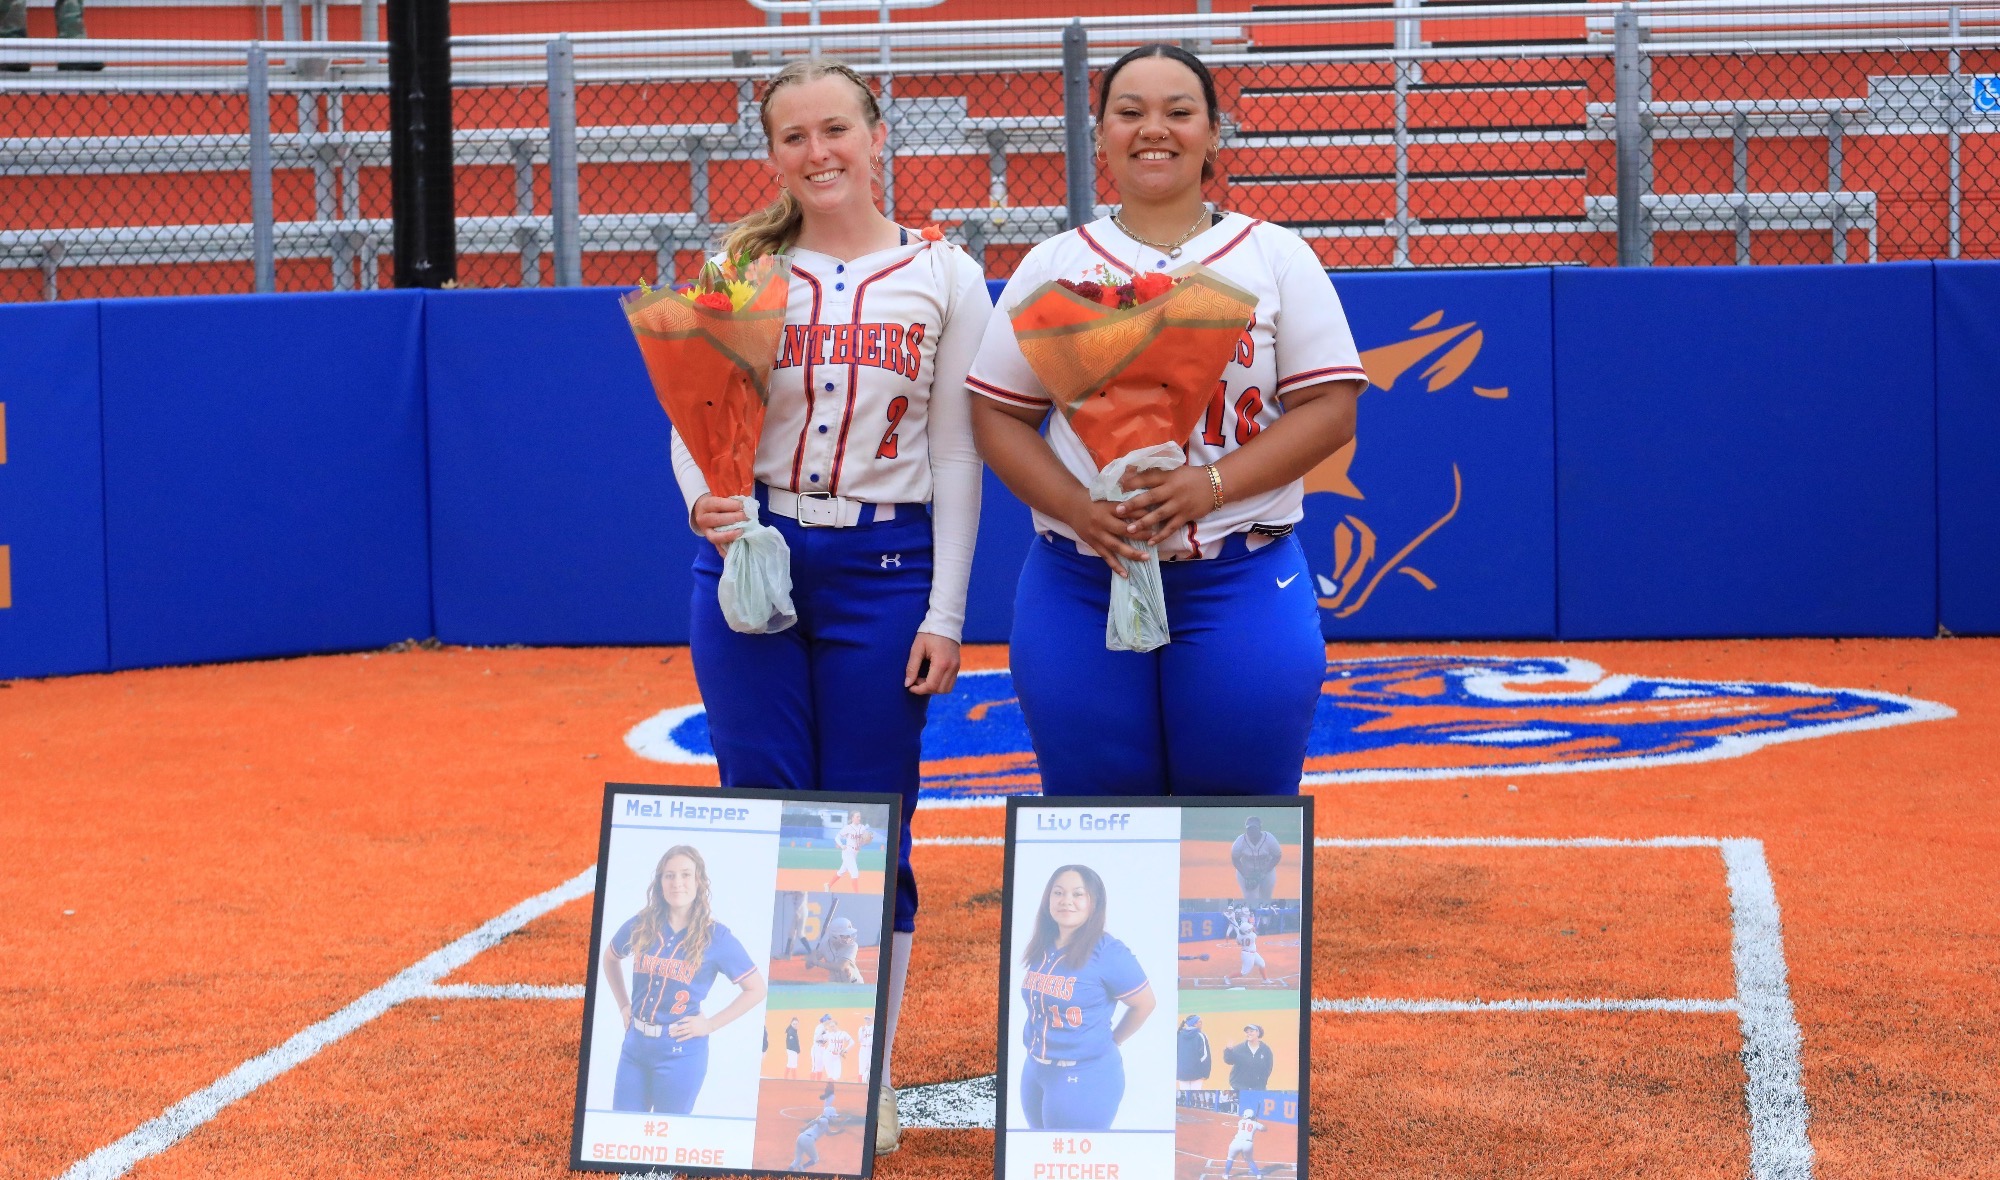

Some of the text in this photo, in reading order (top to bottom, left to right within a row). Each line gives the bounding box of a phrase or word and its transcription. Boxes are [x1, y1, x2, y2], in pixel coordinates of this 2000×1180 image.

[773, 323, 926, 381] NTHERS
[875, 396, 909, 459] 2
[626, 799, 749, 824] Mel Harper
[1037, 813, 1130, 831] Liv Goff
[670, 989, 690, 1015] 2
[1048, 1004, 1083, 1028] 10
[643, 1120, 669, 1138] #2
[592, 1142, 725, 1166] SECOND BASE
[1052, 1137, 1092, 1155] #10
[1033, 1163, 1119, 1180] PITCHER
